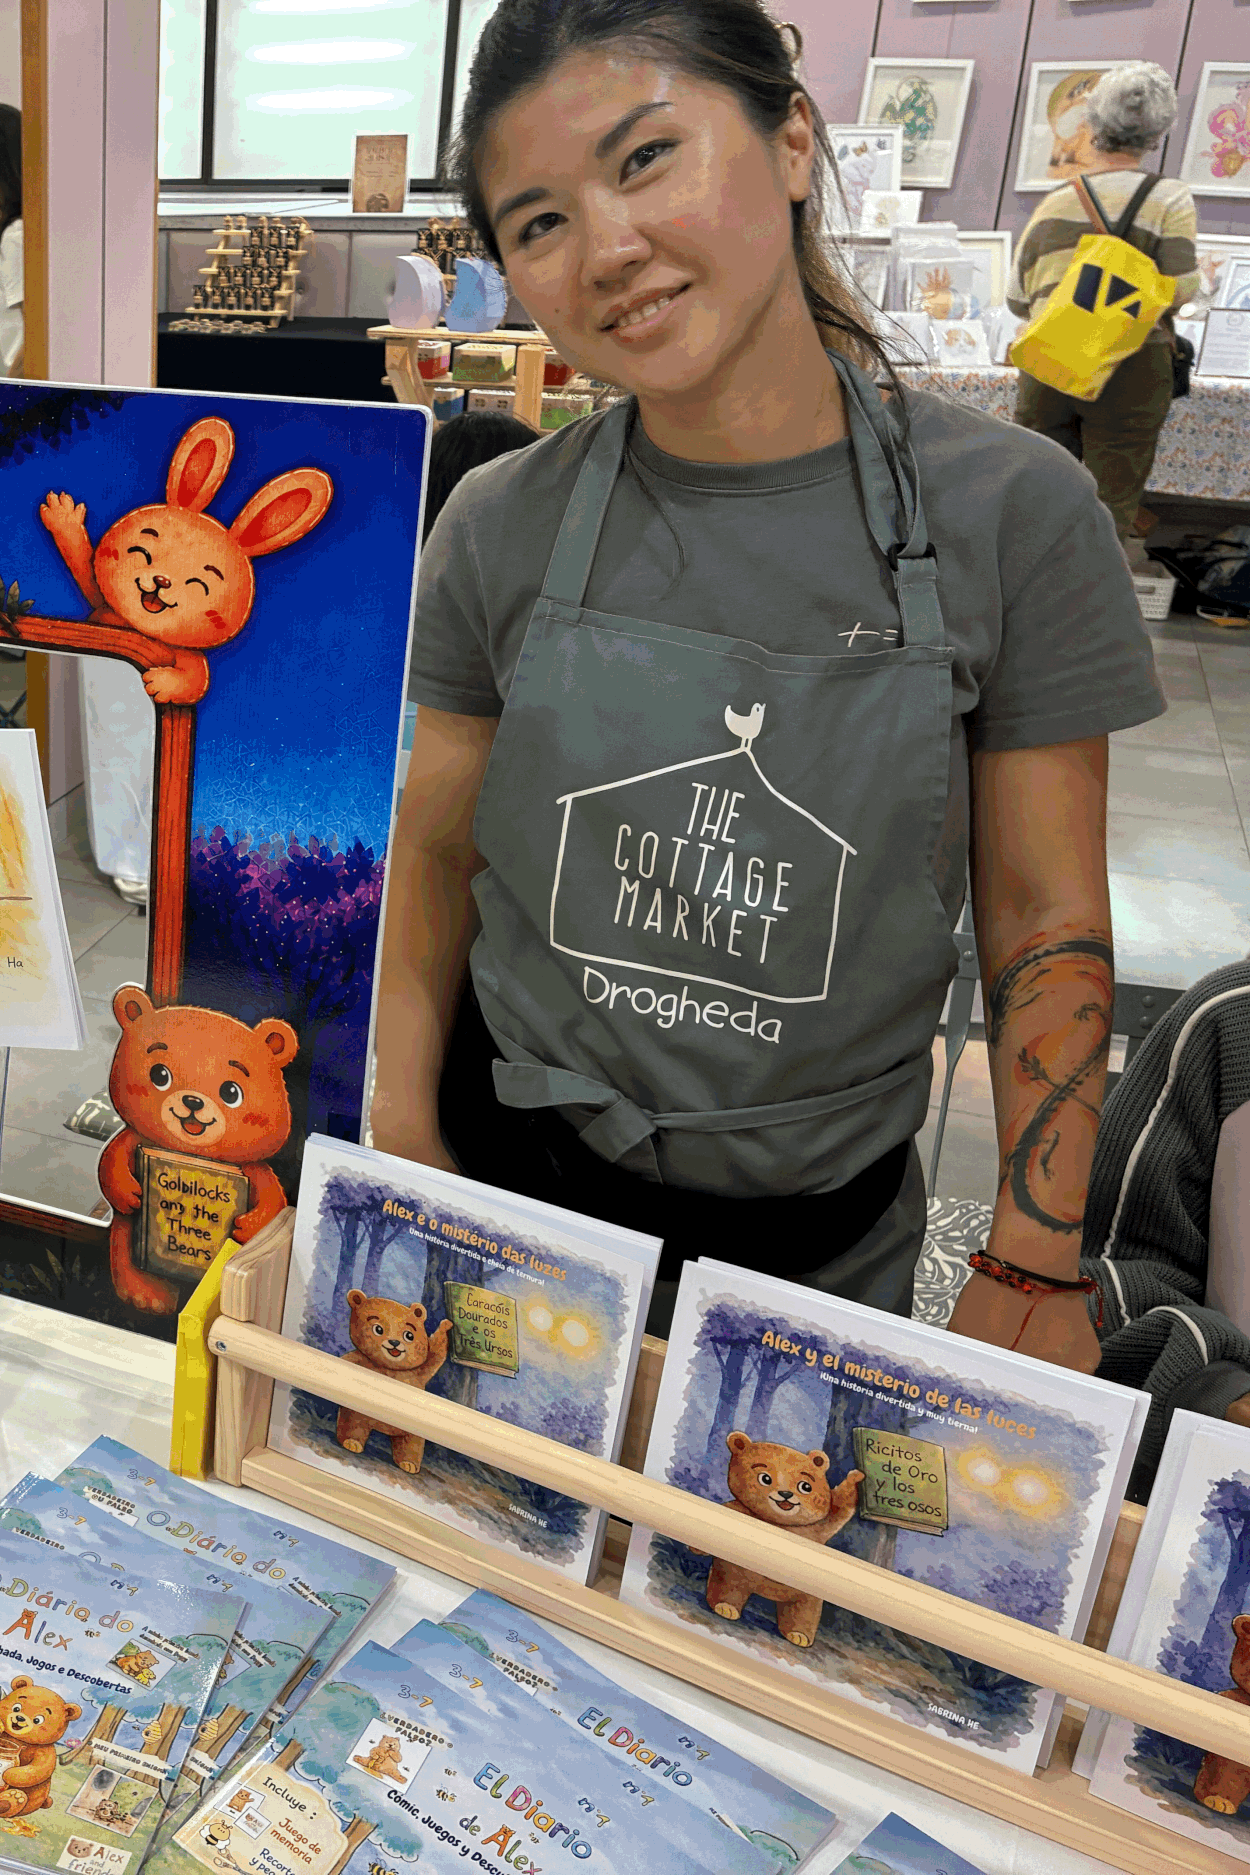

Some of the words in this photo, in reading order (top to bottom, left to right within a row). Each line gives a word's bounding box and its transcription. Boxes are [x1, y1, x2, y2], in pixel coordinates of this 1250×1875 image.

[686, 782, 746, 844] THE
[614, 824, 793, 912] COTTAGE
[614, 876, 778, 963] MARKET
[583, 966, 783, 1043] Drogheda
[192, 1202, 220, 1223] the
[166, 1218, 212, 1242] Three
[382, 1199, 413, 1222] Alex
[417, 1214, 425, 1226] e
[428, 1219, 438, 1231] o
[441, 1221, 498, 1254] mistério
[501, 1245, 526, 1265] das
[529, 1254, 567, 1281] luzes
[167, 1235, 212, 1261] Bears
[458, 1307, 509, 1331] Dourados
[472, 1325, 479, 1334] e
[484, 1328, 496, 1339] os
[459, 1333, 481, 1352] Três
[484, 1339, 514, 1359] Ursos
[761, 1331, 802, 1357] Alex
[805, 1350, 818, 1367] y
[822, 1354, 839, 1371] el
[845, 1360, 921, 1398] misterio
[925, 1388, 949, 1409] de
[955, 1397, 981, 1419] las
[986, 1410, 1037, 1440] luces
[841, 1377, 874, 1398] historia
[875, 1389, 916, 1412] divertida
[918, 1406, 924, 1417] y
[926, 1409, 945, 1424] muy
[947, 1415, 978, 1435] tierna!
[865, 1437, 923, 1463] Ricitos
[876, 1479, 886, 1495] y
[892, 1476, 915, 1494] los
[881, 1458, 902, 1476] de
[908, 1463, 938, 1484] Oro
[509, 1503, 537, 1525] SABRINA
[538, 1518, 548, 1529] HE
[873, 1489, 907, 1511] tres
[907, 1498, 942, 1517] osos
[6, 1578, 91, 1622] Diário
[98, 1611, 134, 1633] do
[2, 1607, 73, 1651] Alex
[26, 1656, 57, 1673] Jogos
[58, 1665, 65, 1675] e
[66, 1668, 132, 1695] Descobertas
[927, 1702, 966, 1726] SABRINA
[967, 1718, 980, 1731] HE
[473, 1762, 510, 1799] El
[505, 1785, 592, 1860] Diario
